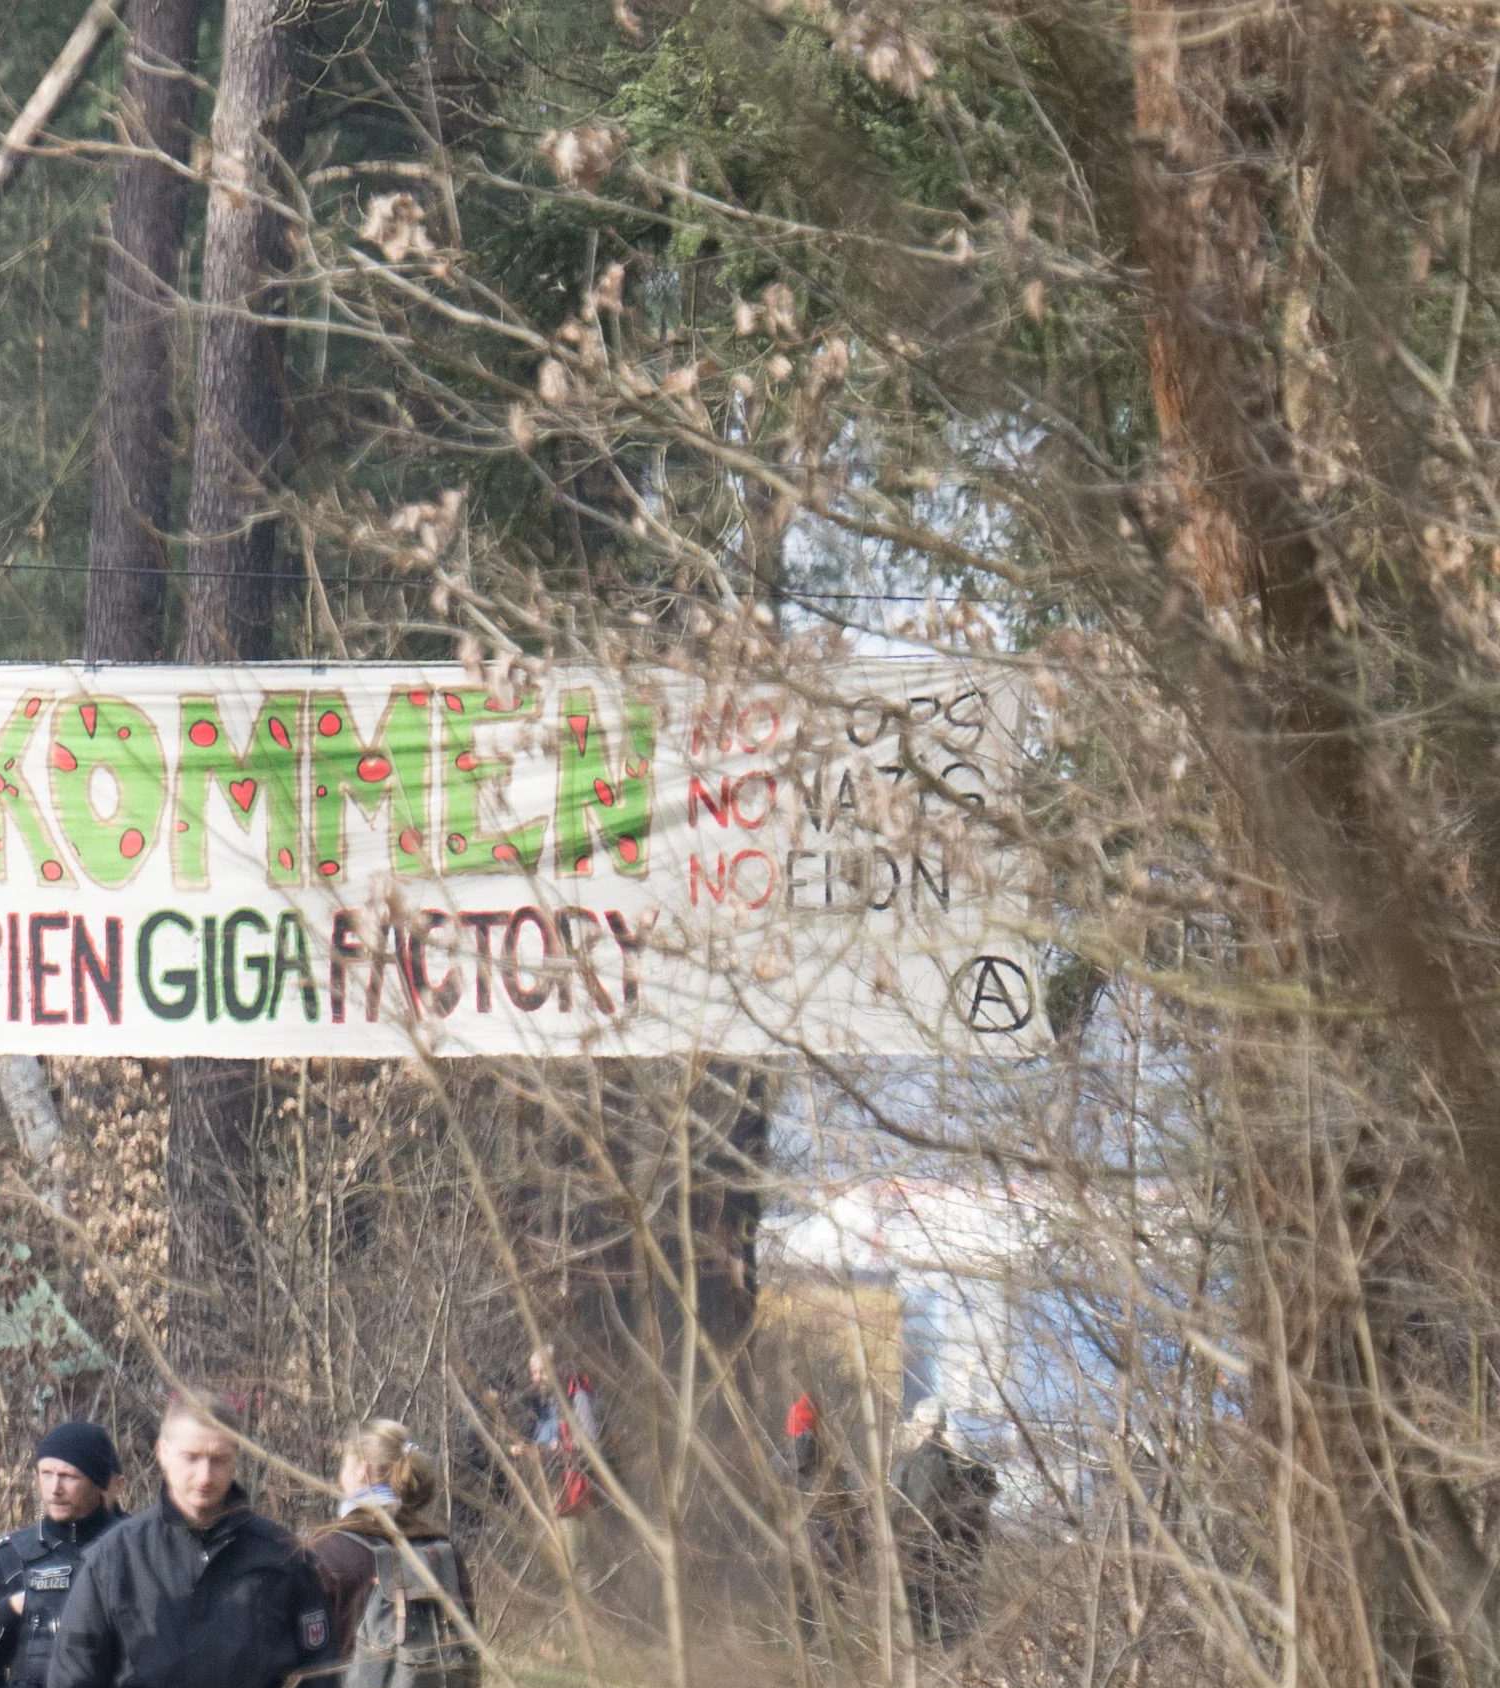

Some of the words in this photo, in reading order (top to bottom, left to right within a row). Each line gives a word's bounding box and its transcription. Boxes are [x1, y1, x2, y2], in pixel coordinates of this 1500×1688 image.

[690, 697, 781, 755] NO
[688, 770, 778, 830] NO
[688, 849, 778, 910] NO
[136, 906, 321, 1024] GIGA
[330, 904, 661, 1024] FACTORY
[31, 1577, 69, 1590] POLIZEI
